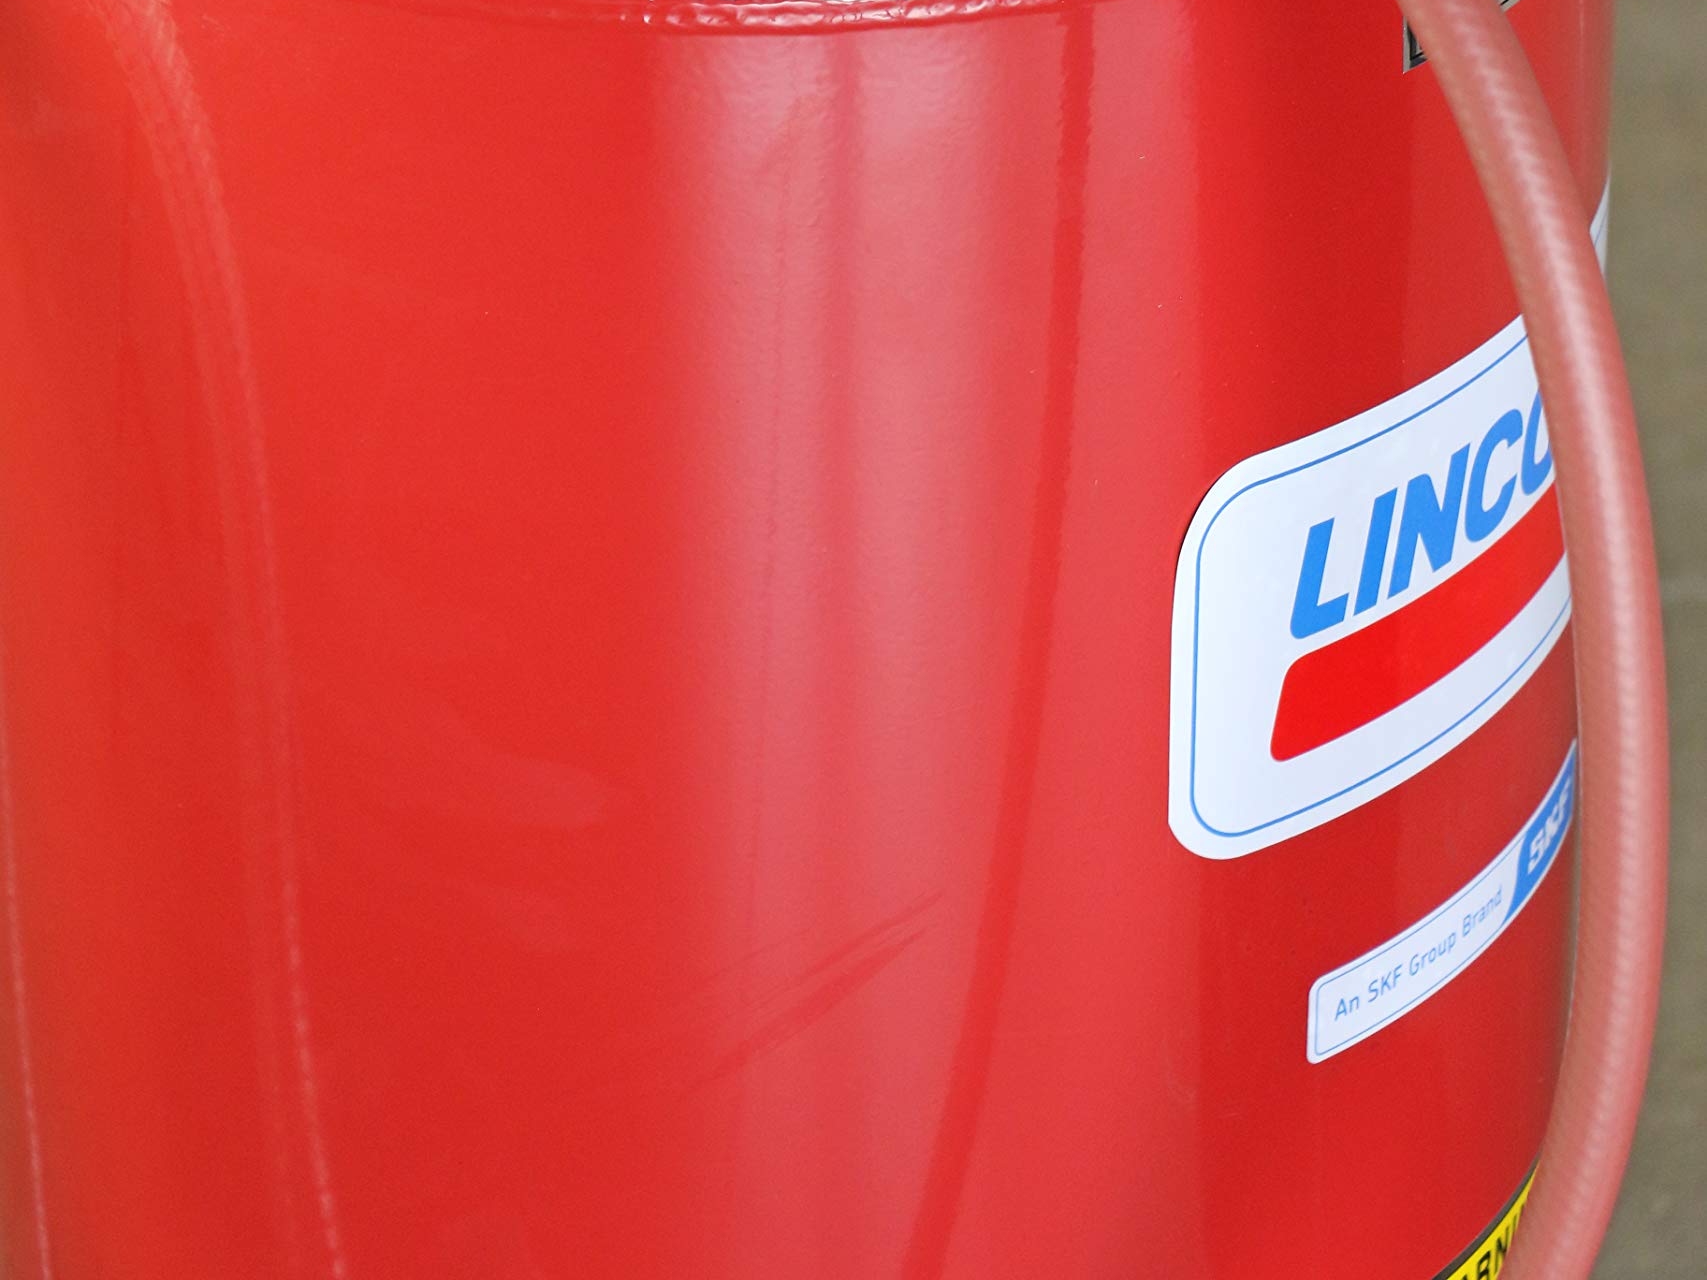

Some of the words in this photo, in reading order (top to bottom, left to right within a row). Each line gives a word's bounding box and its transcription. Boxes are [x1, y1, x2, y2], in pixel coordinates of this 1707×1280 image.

[1527, 773, 1572, 876] SKF
[1334, 994, 1360, 1021] An
[1368, 964, 1402, 1004] SKF
[1408, 932, 1457, 977] Group
[1462, 883, 1503, 939] Brand
